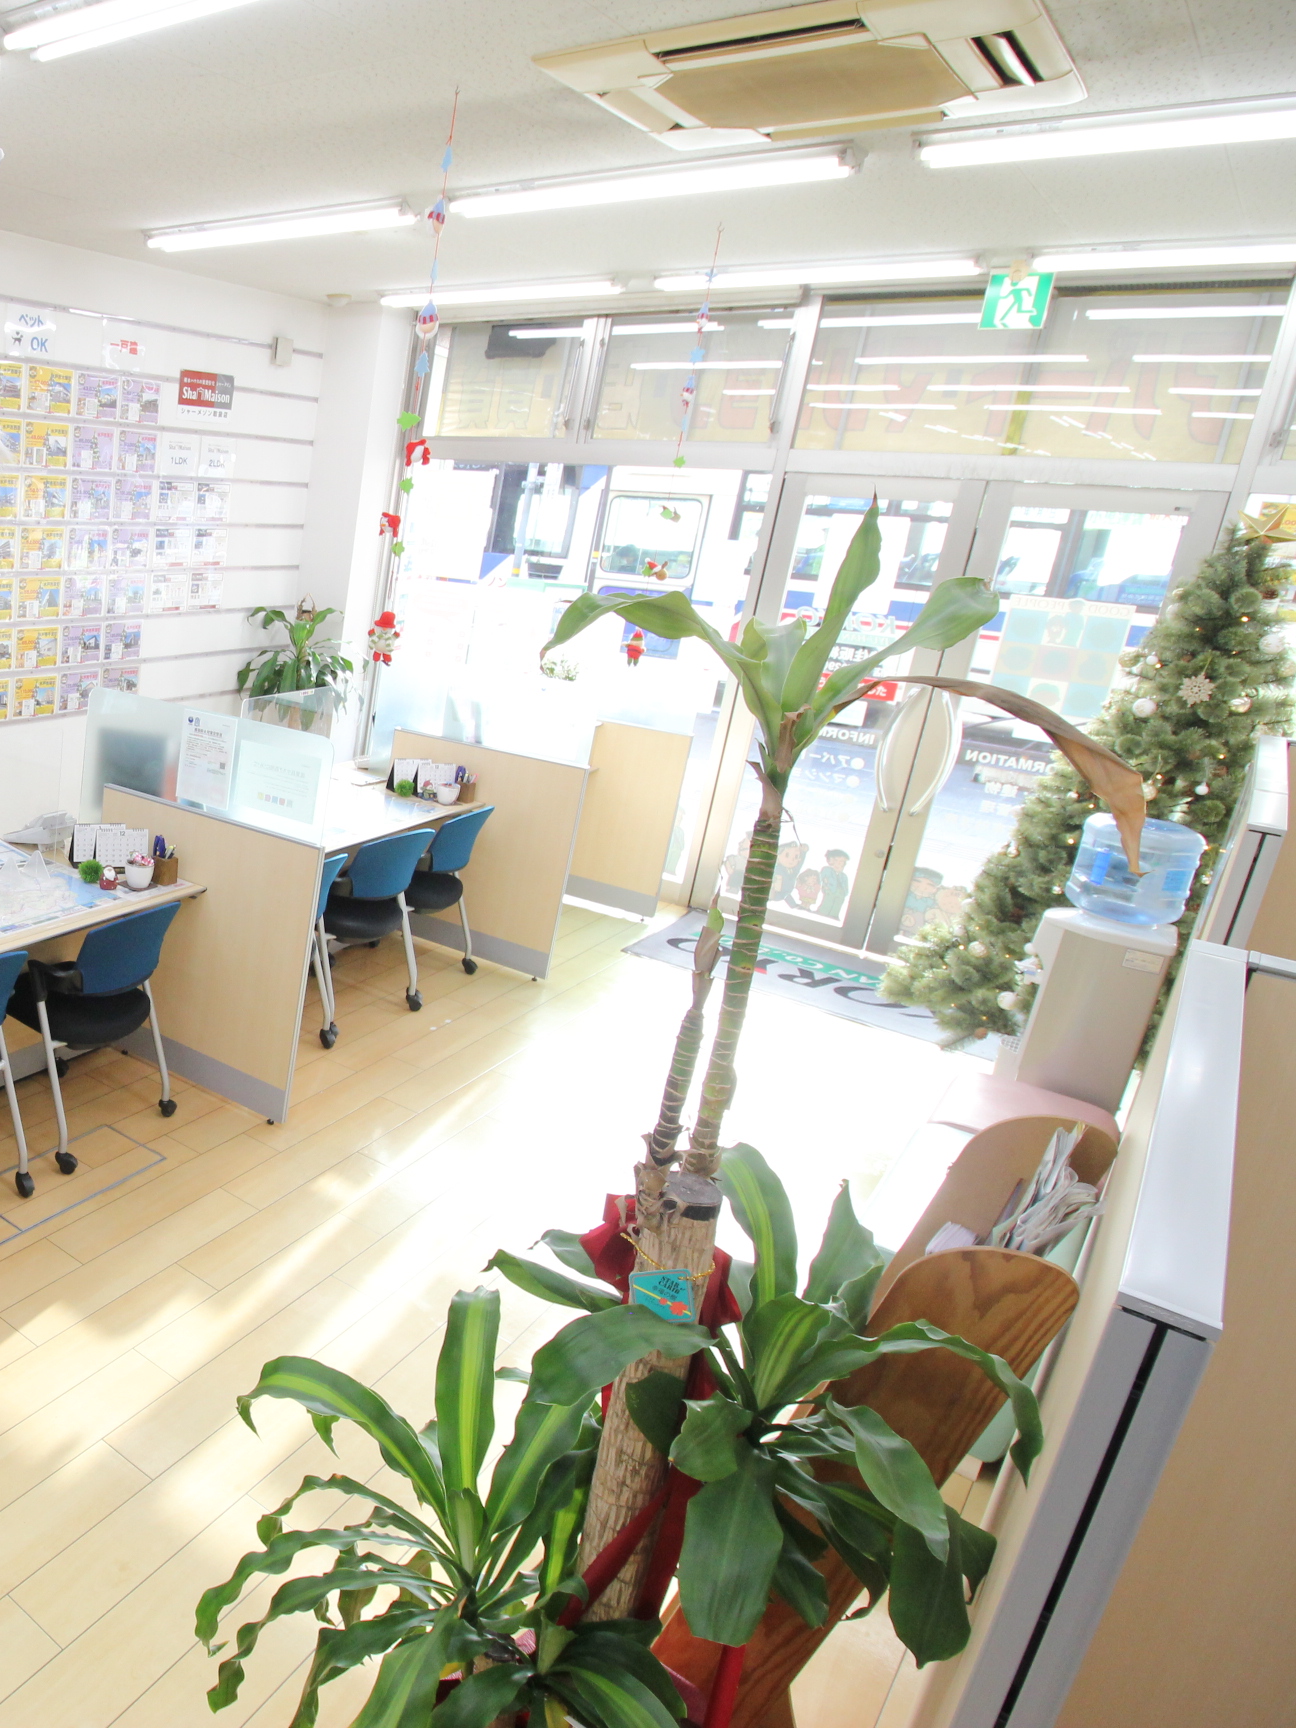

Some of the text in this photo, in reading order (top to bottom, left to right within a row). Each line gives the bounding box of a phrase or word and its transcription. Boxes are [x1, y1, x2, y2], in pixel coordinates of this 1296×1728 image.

[30, 335, 49, 353] OK
[182, 386, 231, 404] Sha Maison
[180, 407, 229, 419] シャーメゾン取扱店
[170, 456, 188, 465] 1LDK
